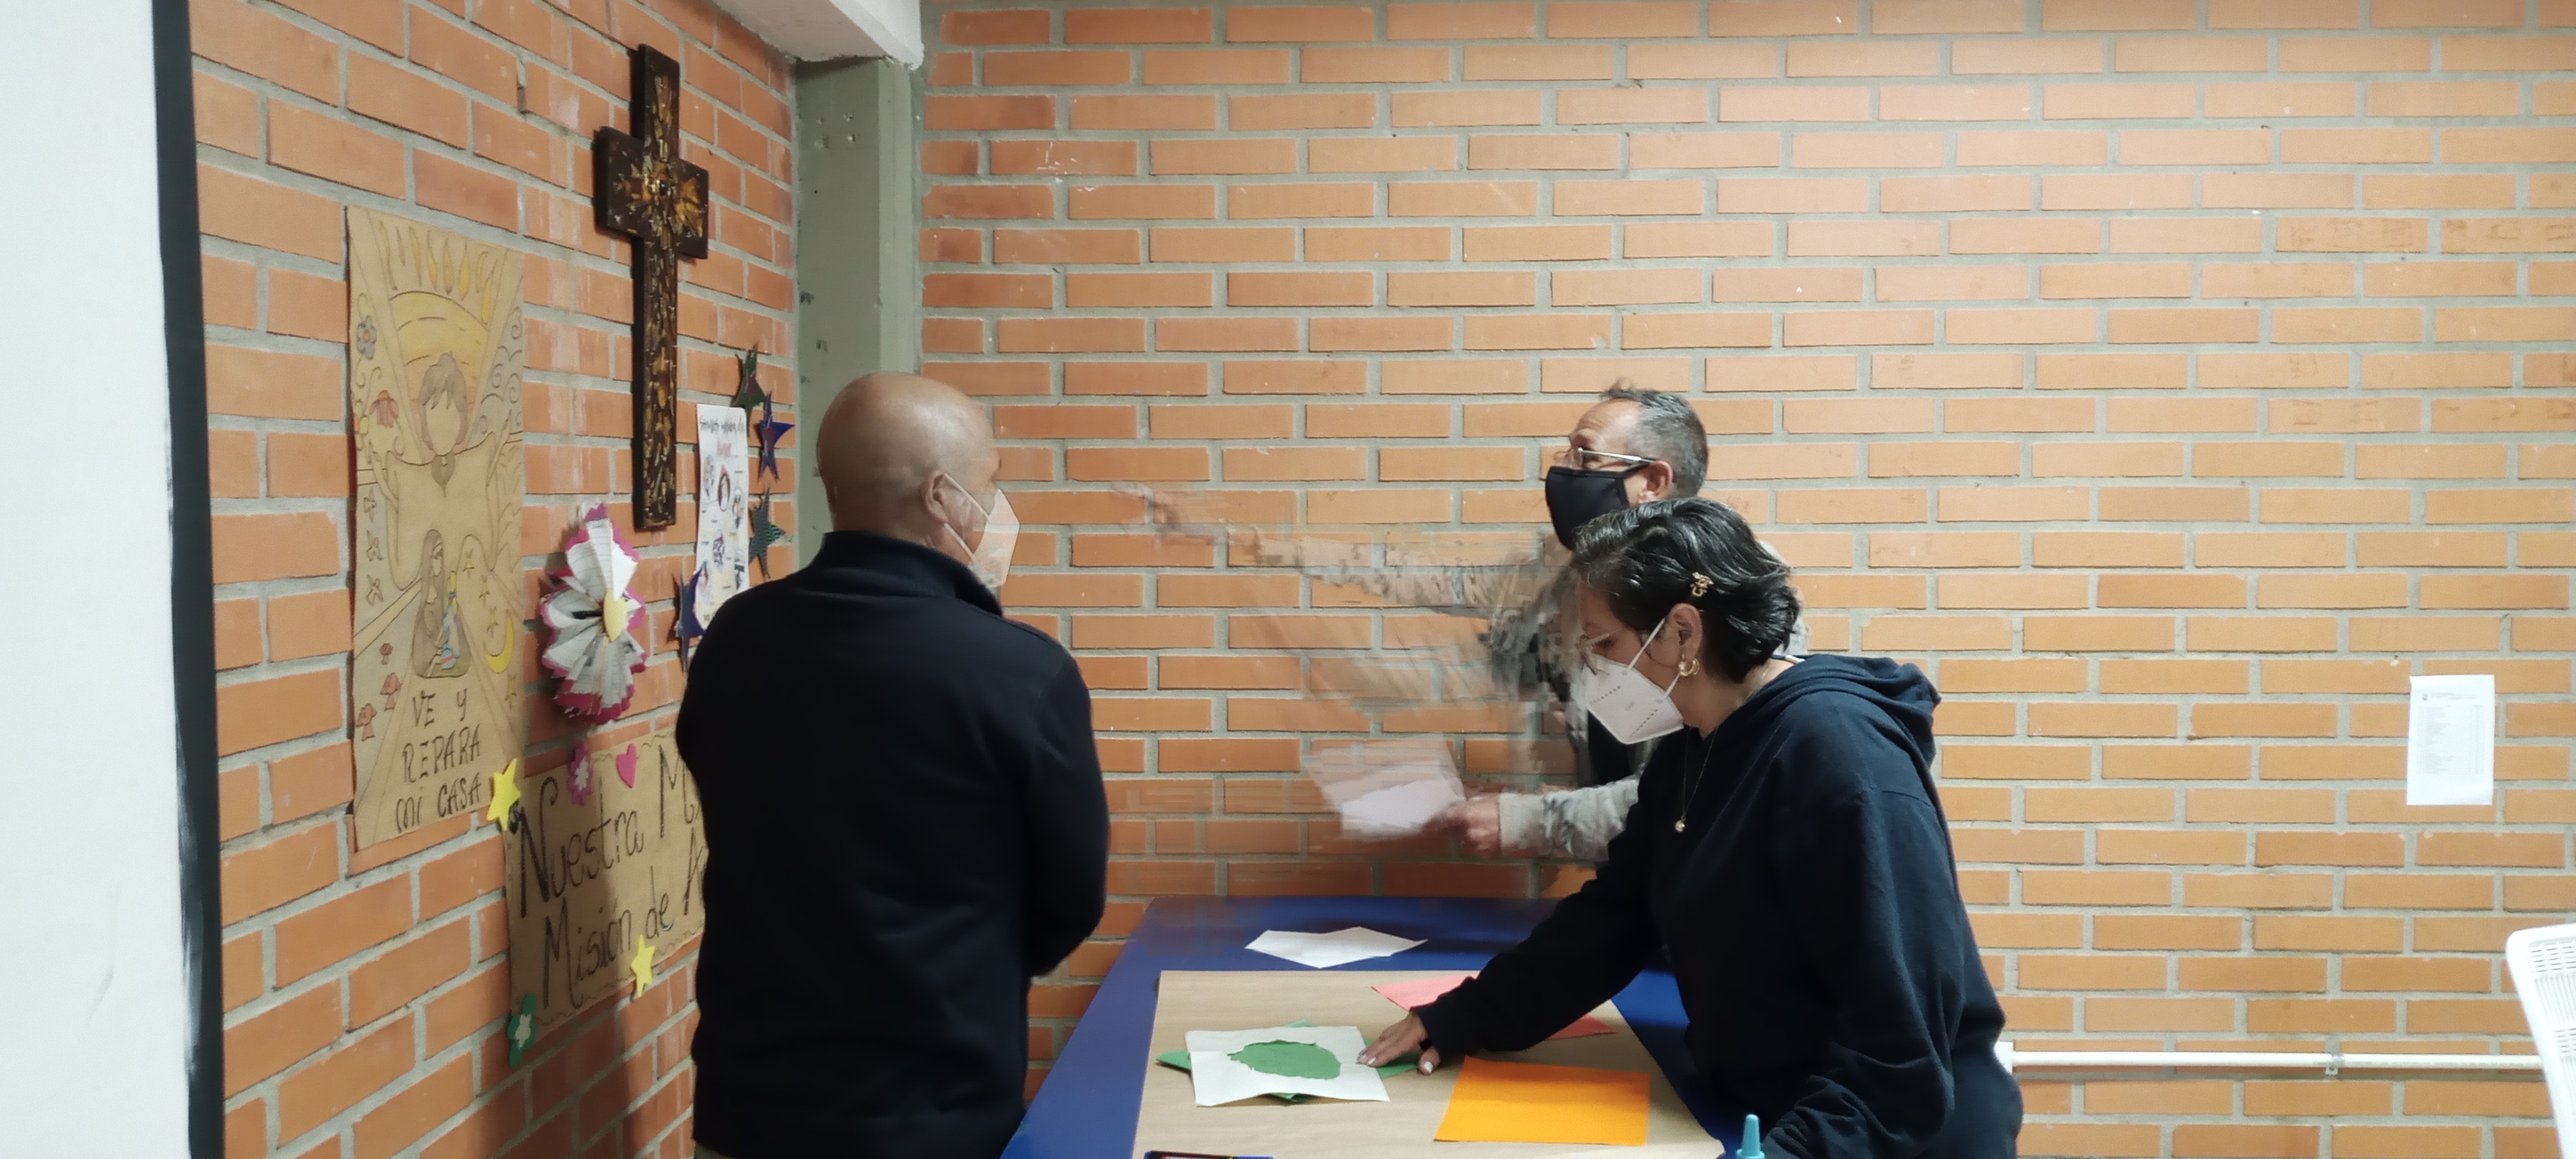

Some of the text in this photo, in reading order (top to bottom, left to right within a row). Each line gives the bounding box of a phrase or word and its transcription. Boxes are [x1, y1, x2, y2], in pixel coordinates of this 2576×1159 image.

[412, 690, 435, 727] VE
[402, 724, 481, 783] REPARA
[437, 771, 481, 817] CASA
[508, 744, 700, 918] Nuestra M
[543, 827, 706, 1010] Misión de A
